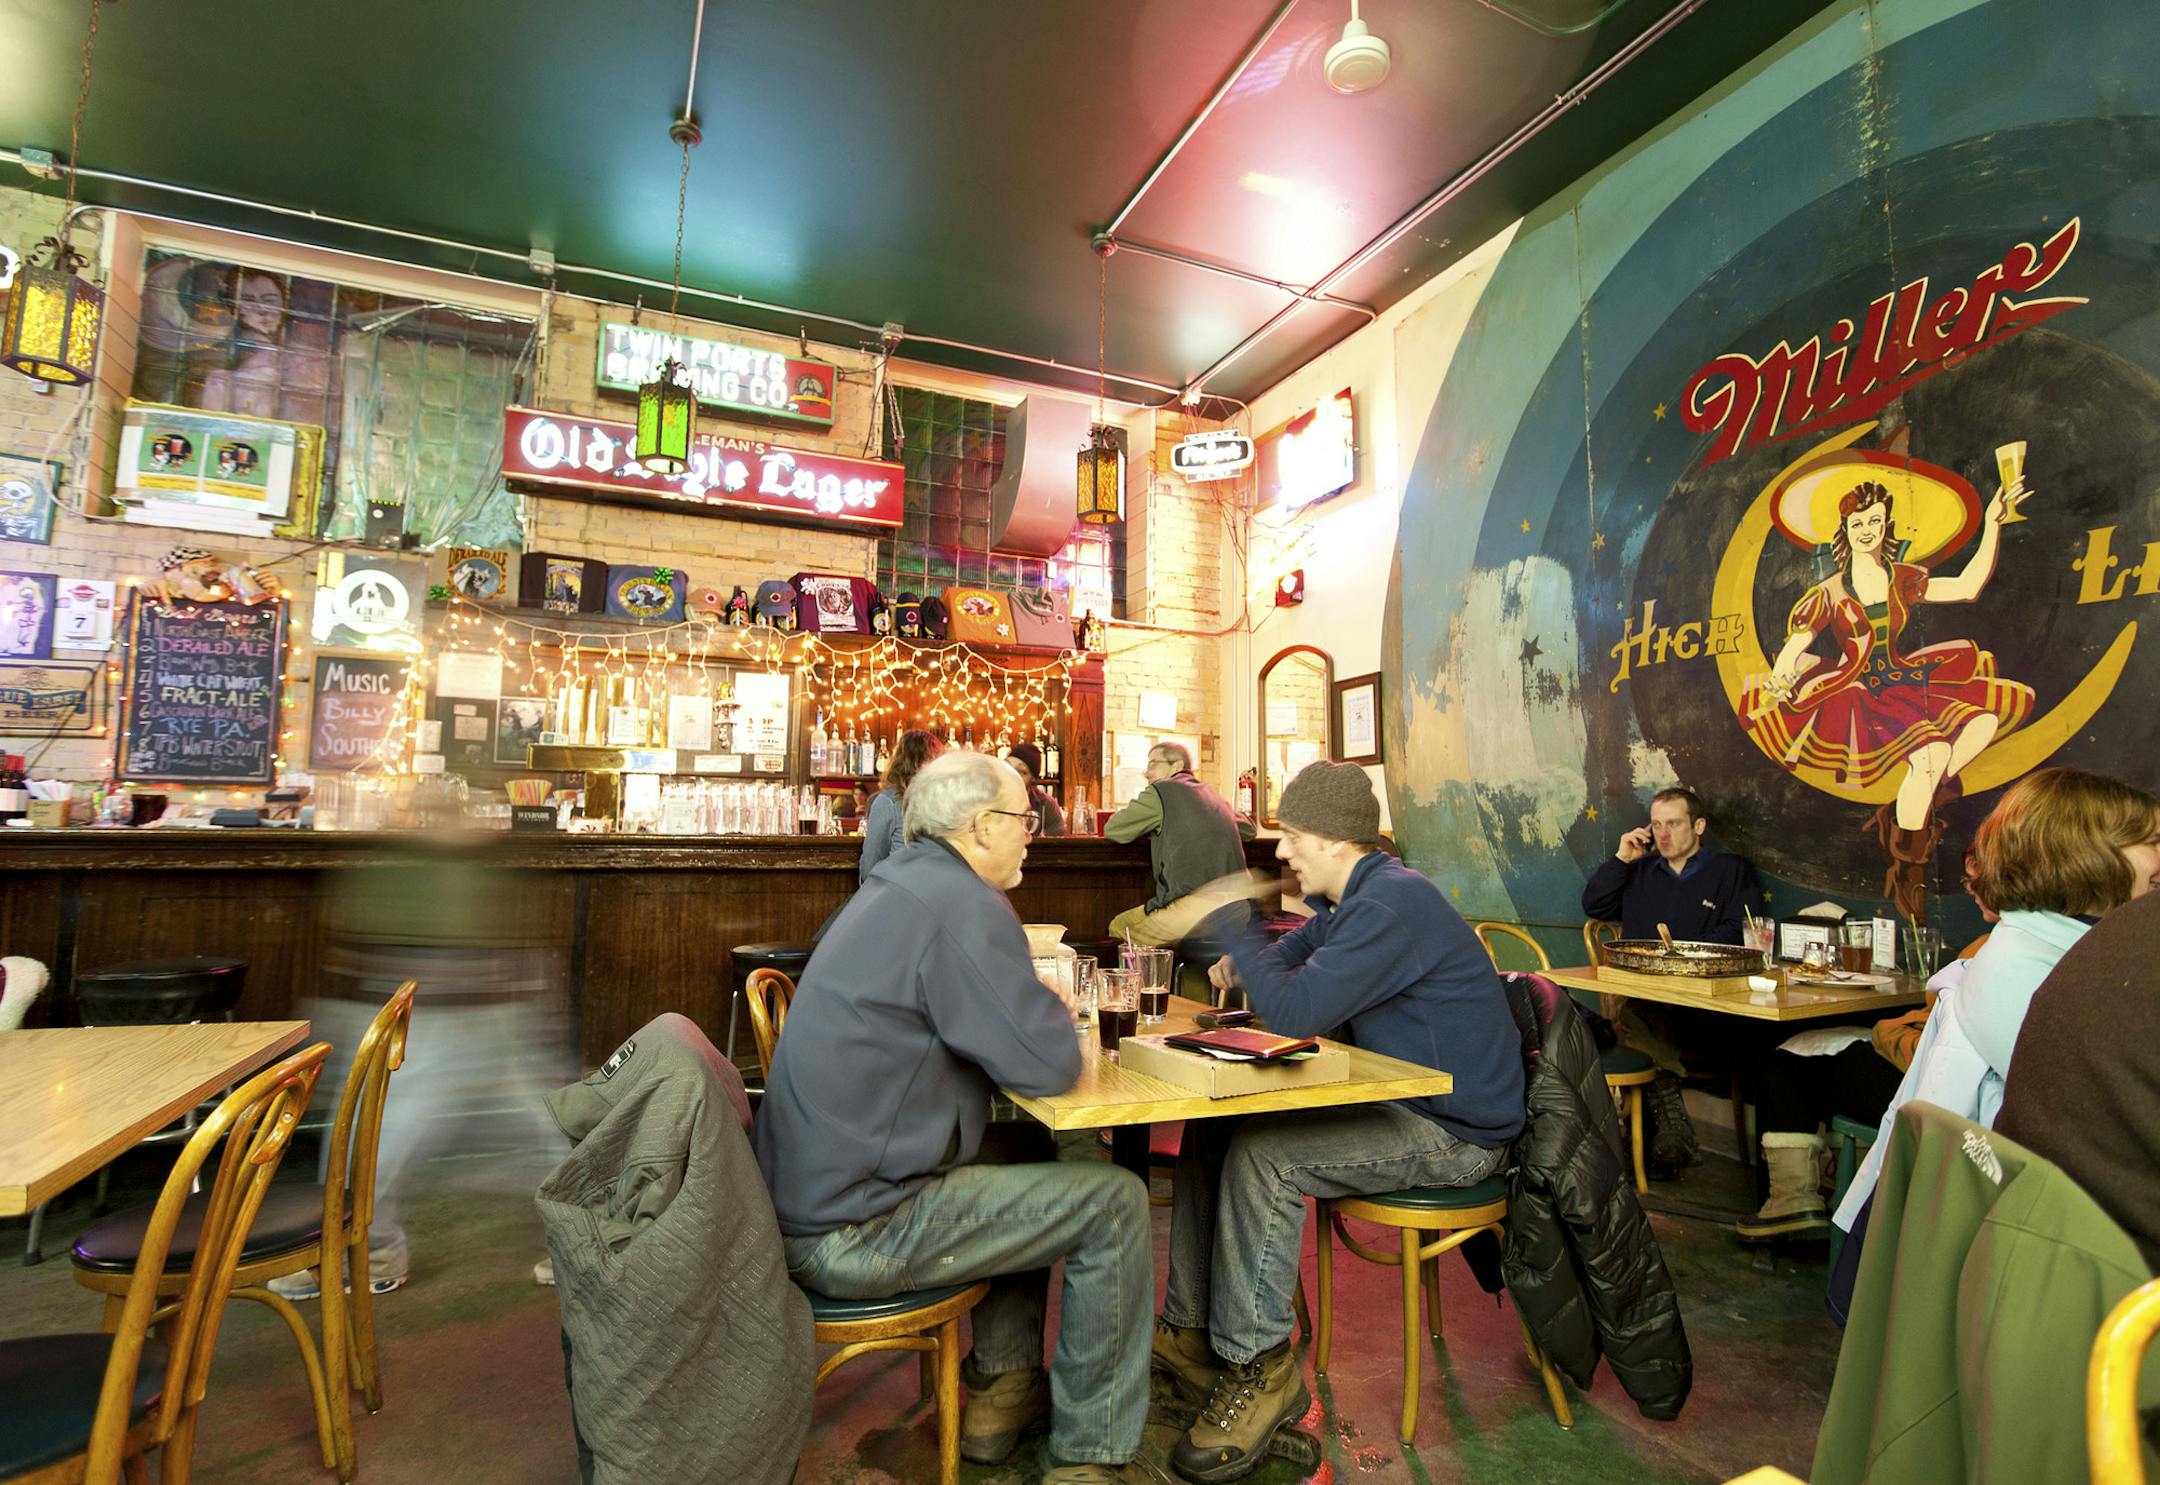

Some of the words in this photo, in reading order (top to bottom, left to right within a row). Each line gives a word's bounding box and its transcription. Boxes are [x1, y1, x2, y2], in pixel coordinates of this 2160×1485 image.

[1682, 216, 2089, 468] Miller
[606, 323, 682, 365] TWIN
[690, 339, 787, 383] PORTS
[521, 417, 616, 473] Old
[758, 452, 889, 514] Lager
[74, 617, 86, 629] 7
[139, 638, 155, 653] 2
[155, 637, 234, 656] DERAILED
[236, 642, 269, 657] ALE
[138, 669, 153, 689] 4
[322, 662, 392, 695] MUSIC
[138, 689, 152, 703] 5
[160, 686, 263, 707] FRACT-ALE
[138, 704, 151, 719] 6
[320, 697, 387, 725] BILLY
[138, 720, 151, 735] 7
[159, 718, 201, 735] RYE
